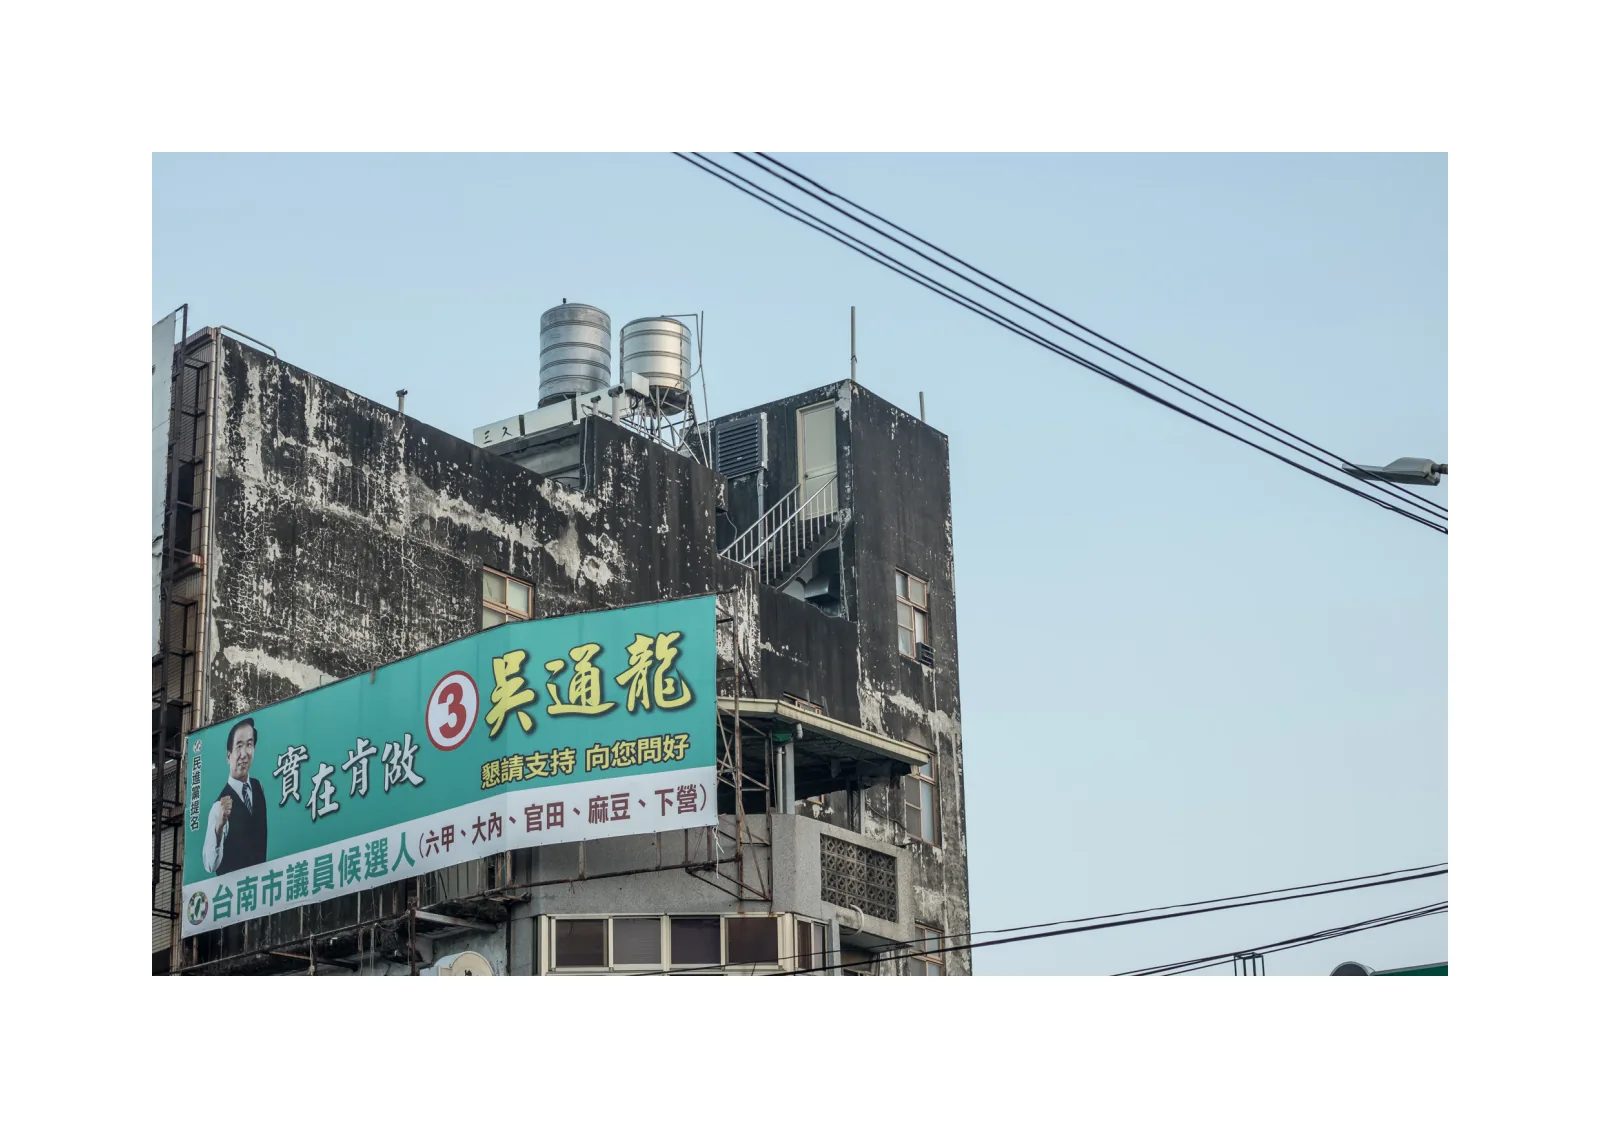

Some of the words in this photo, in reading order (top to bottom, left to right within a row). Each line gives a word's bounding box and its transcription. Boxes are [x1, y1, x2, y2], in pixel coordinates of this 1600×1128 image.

[436, 682, 468, 740] 3
[484, 630, 693, 738] 吳通龍
[190, 755, 201, 831] 民進黨提名
[272, 732, 425, 822] 實在肯做
[480, 747, 578, 791] 懇請支持
[585, 733, 691, 772] 向您問好
[211, 831, 416, 922] 台南市議員候選人
